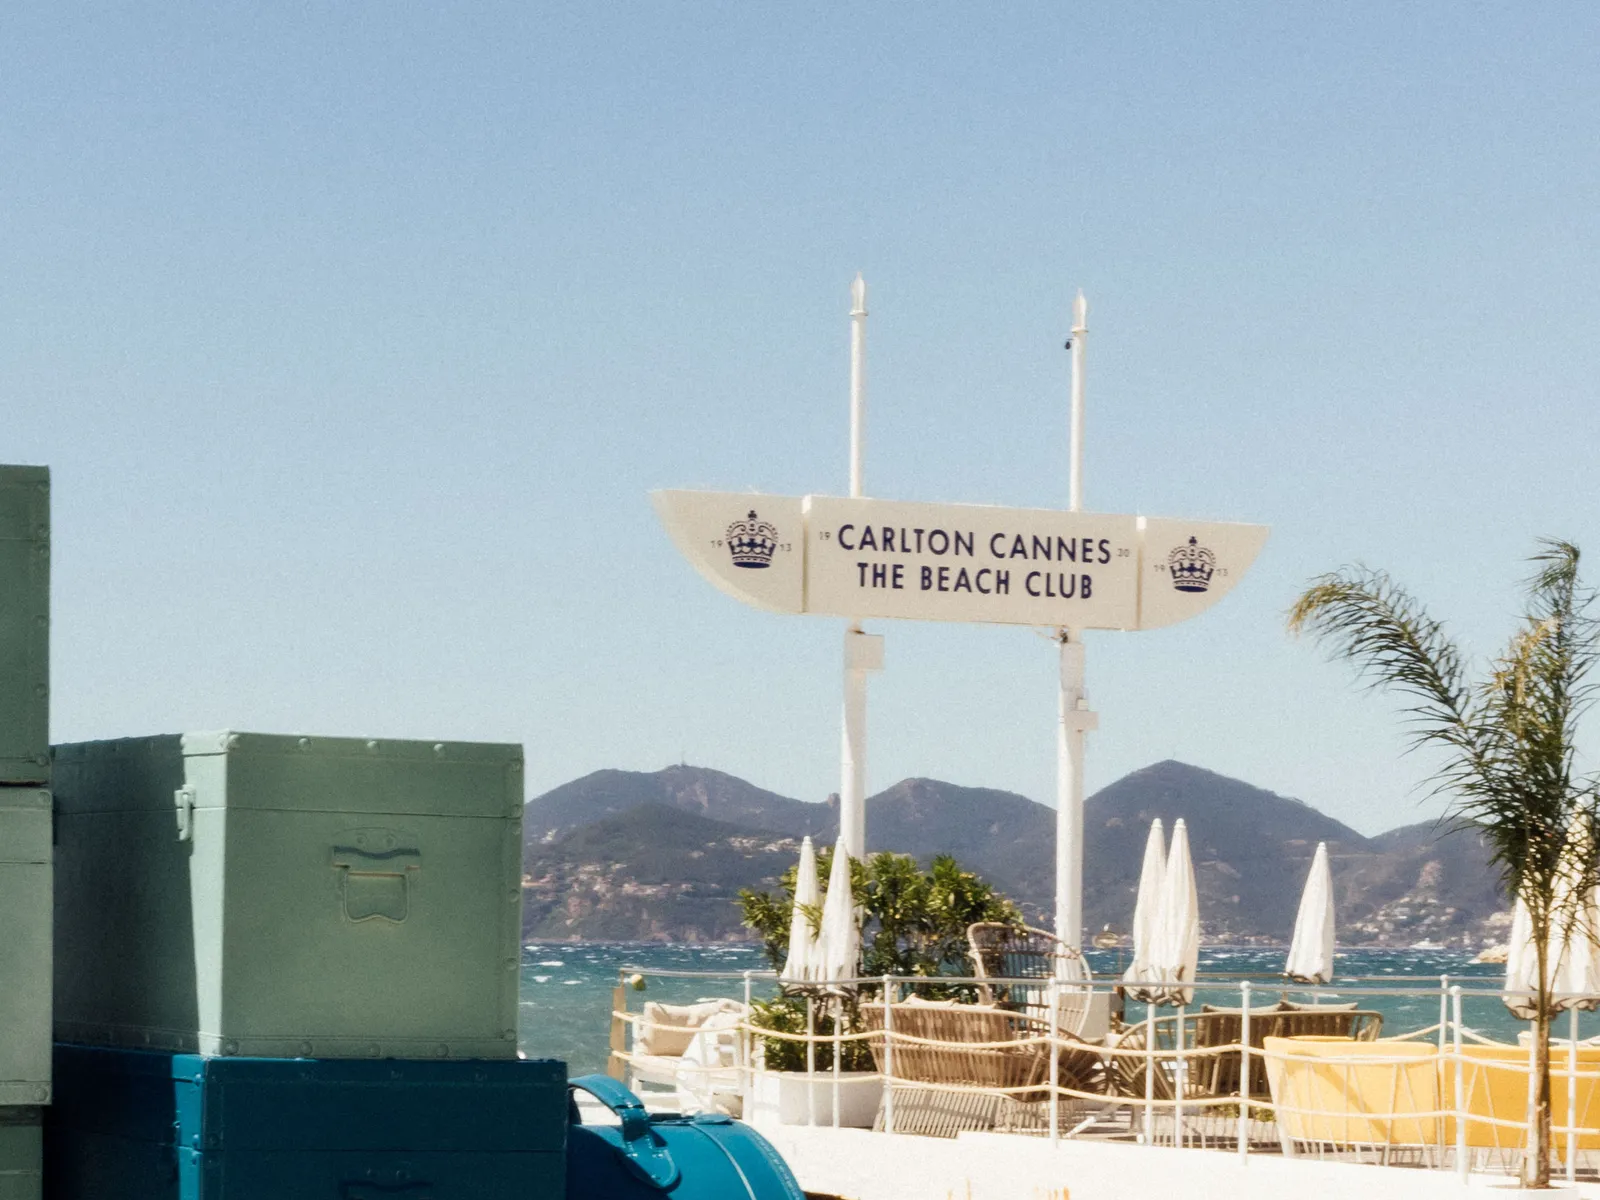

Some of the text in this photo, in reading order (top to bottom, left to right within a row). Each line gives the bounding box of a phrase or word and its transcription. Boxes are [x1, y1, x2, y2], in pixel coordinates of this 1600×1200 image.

[819, 530, 831, 541] 19
[837, 524, 1111, 565] CARLTON CANNES
[856, 562, 1093, 600] THE BEACH CLUB
